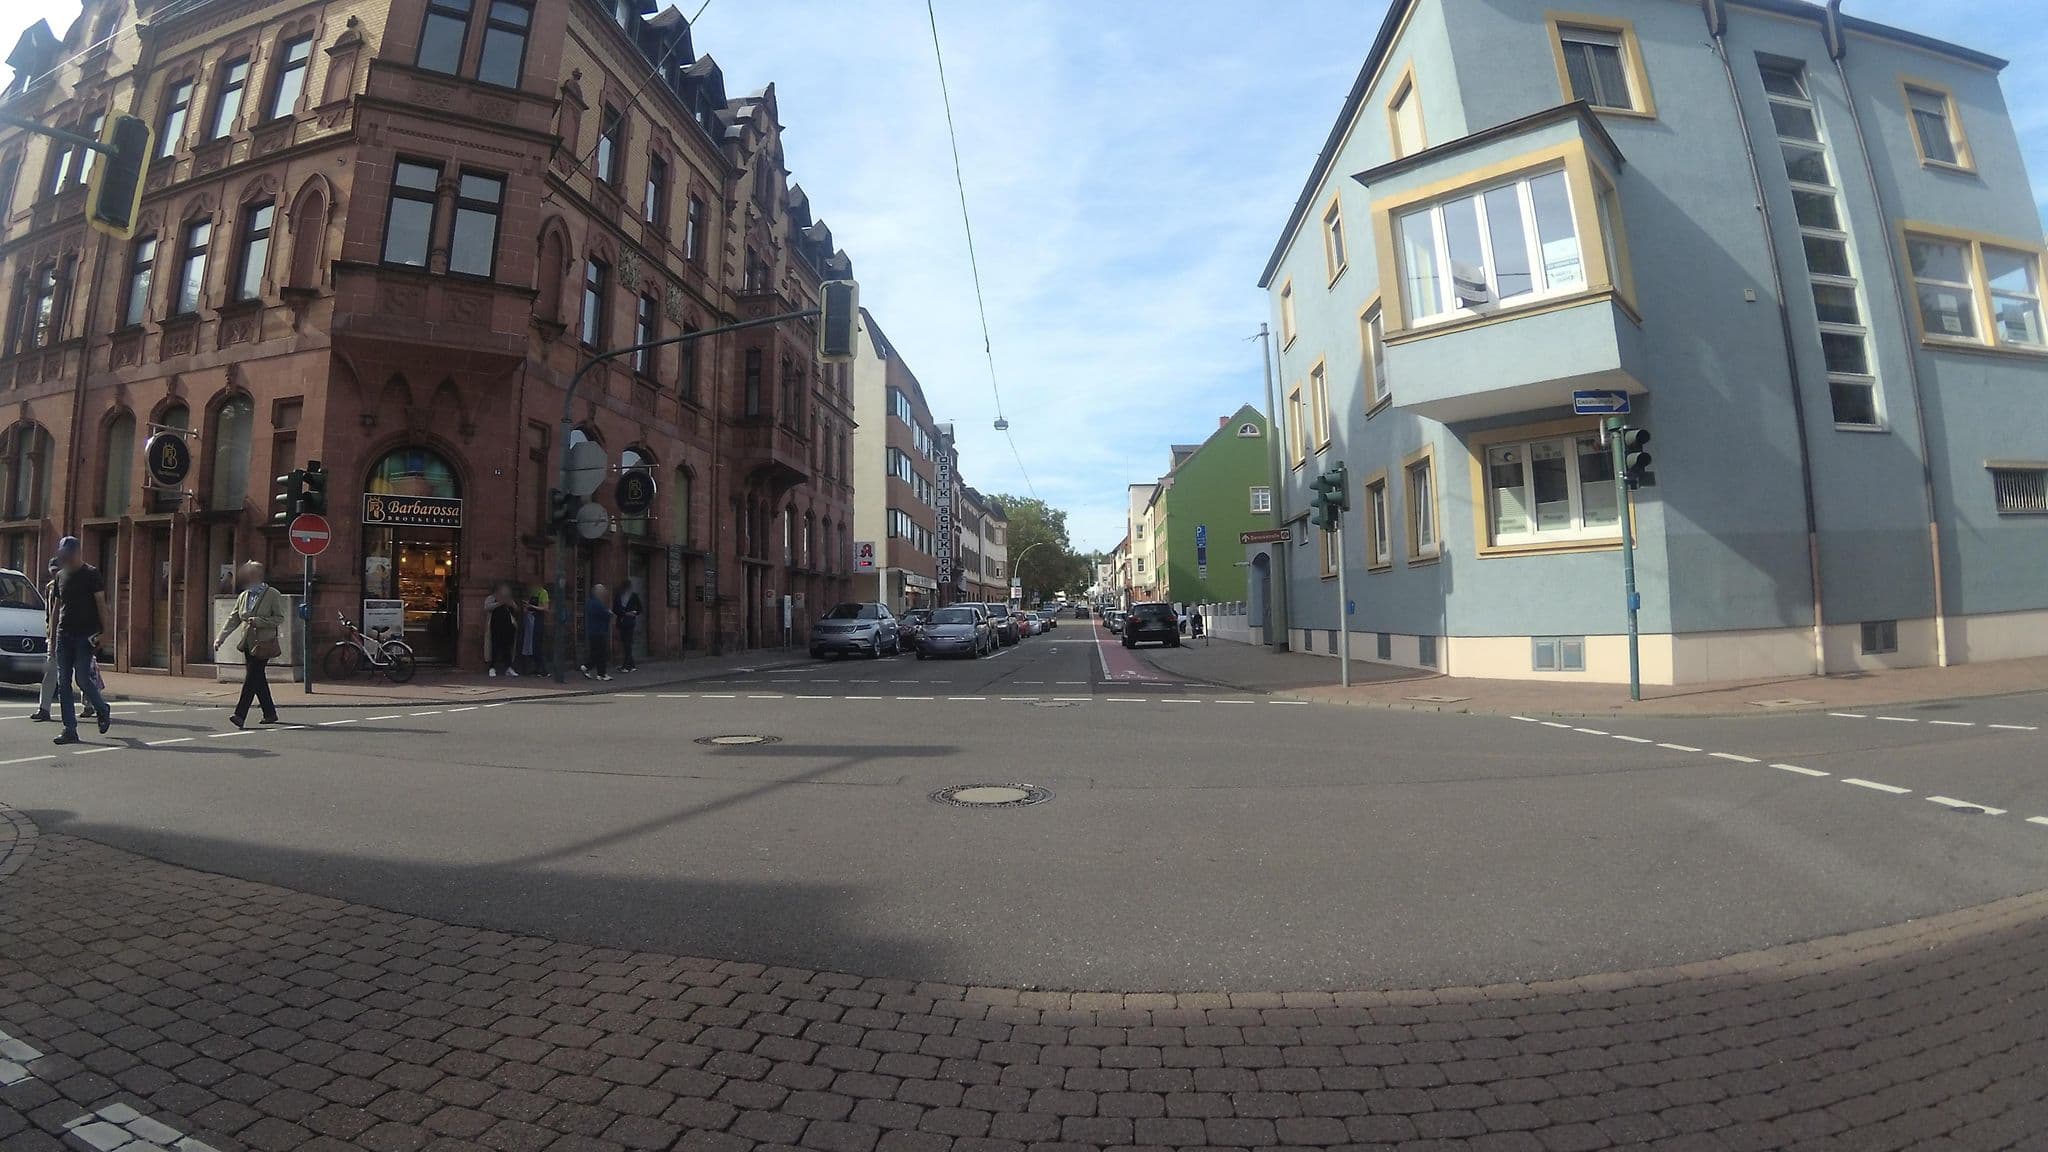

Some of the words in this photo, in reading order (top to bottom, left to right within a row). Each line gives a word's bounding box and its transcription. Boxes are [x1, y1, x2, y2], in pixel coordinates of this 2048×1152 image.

[940, 456, 948, 497] OPTIK
[388, 500, 460, 516] Barbarossa
[1197, 526, 1202, 537] P
